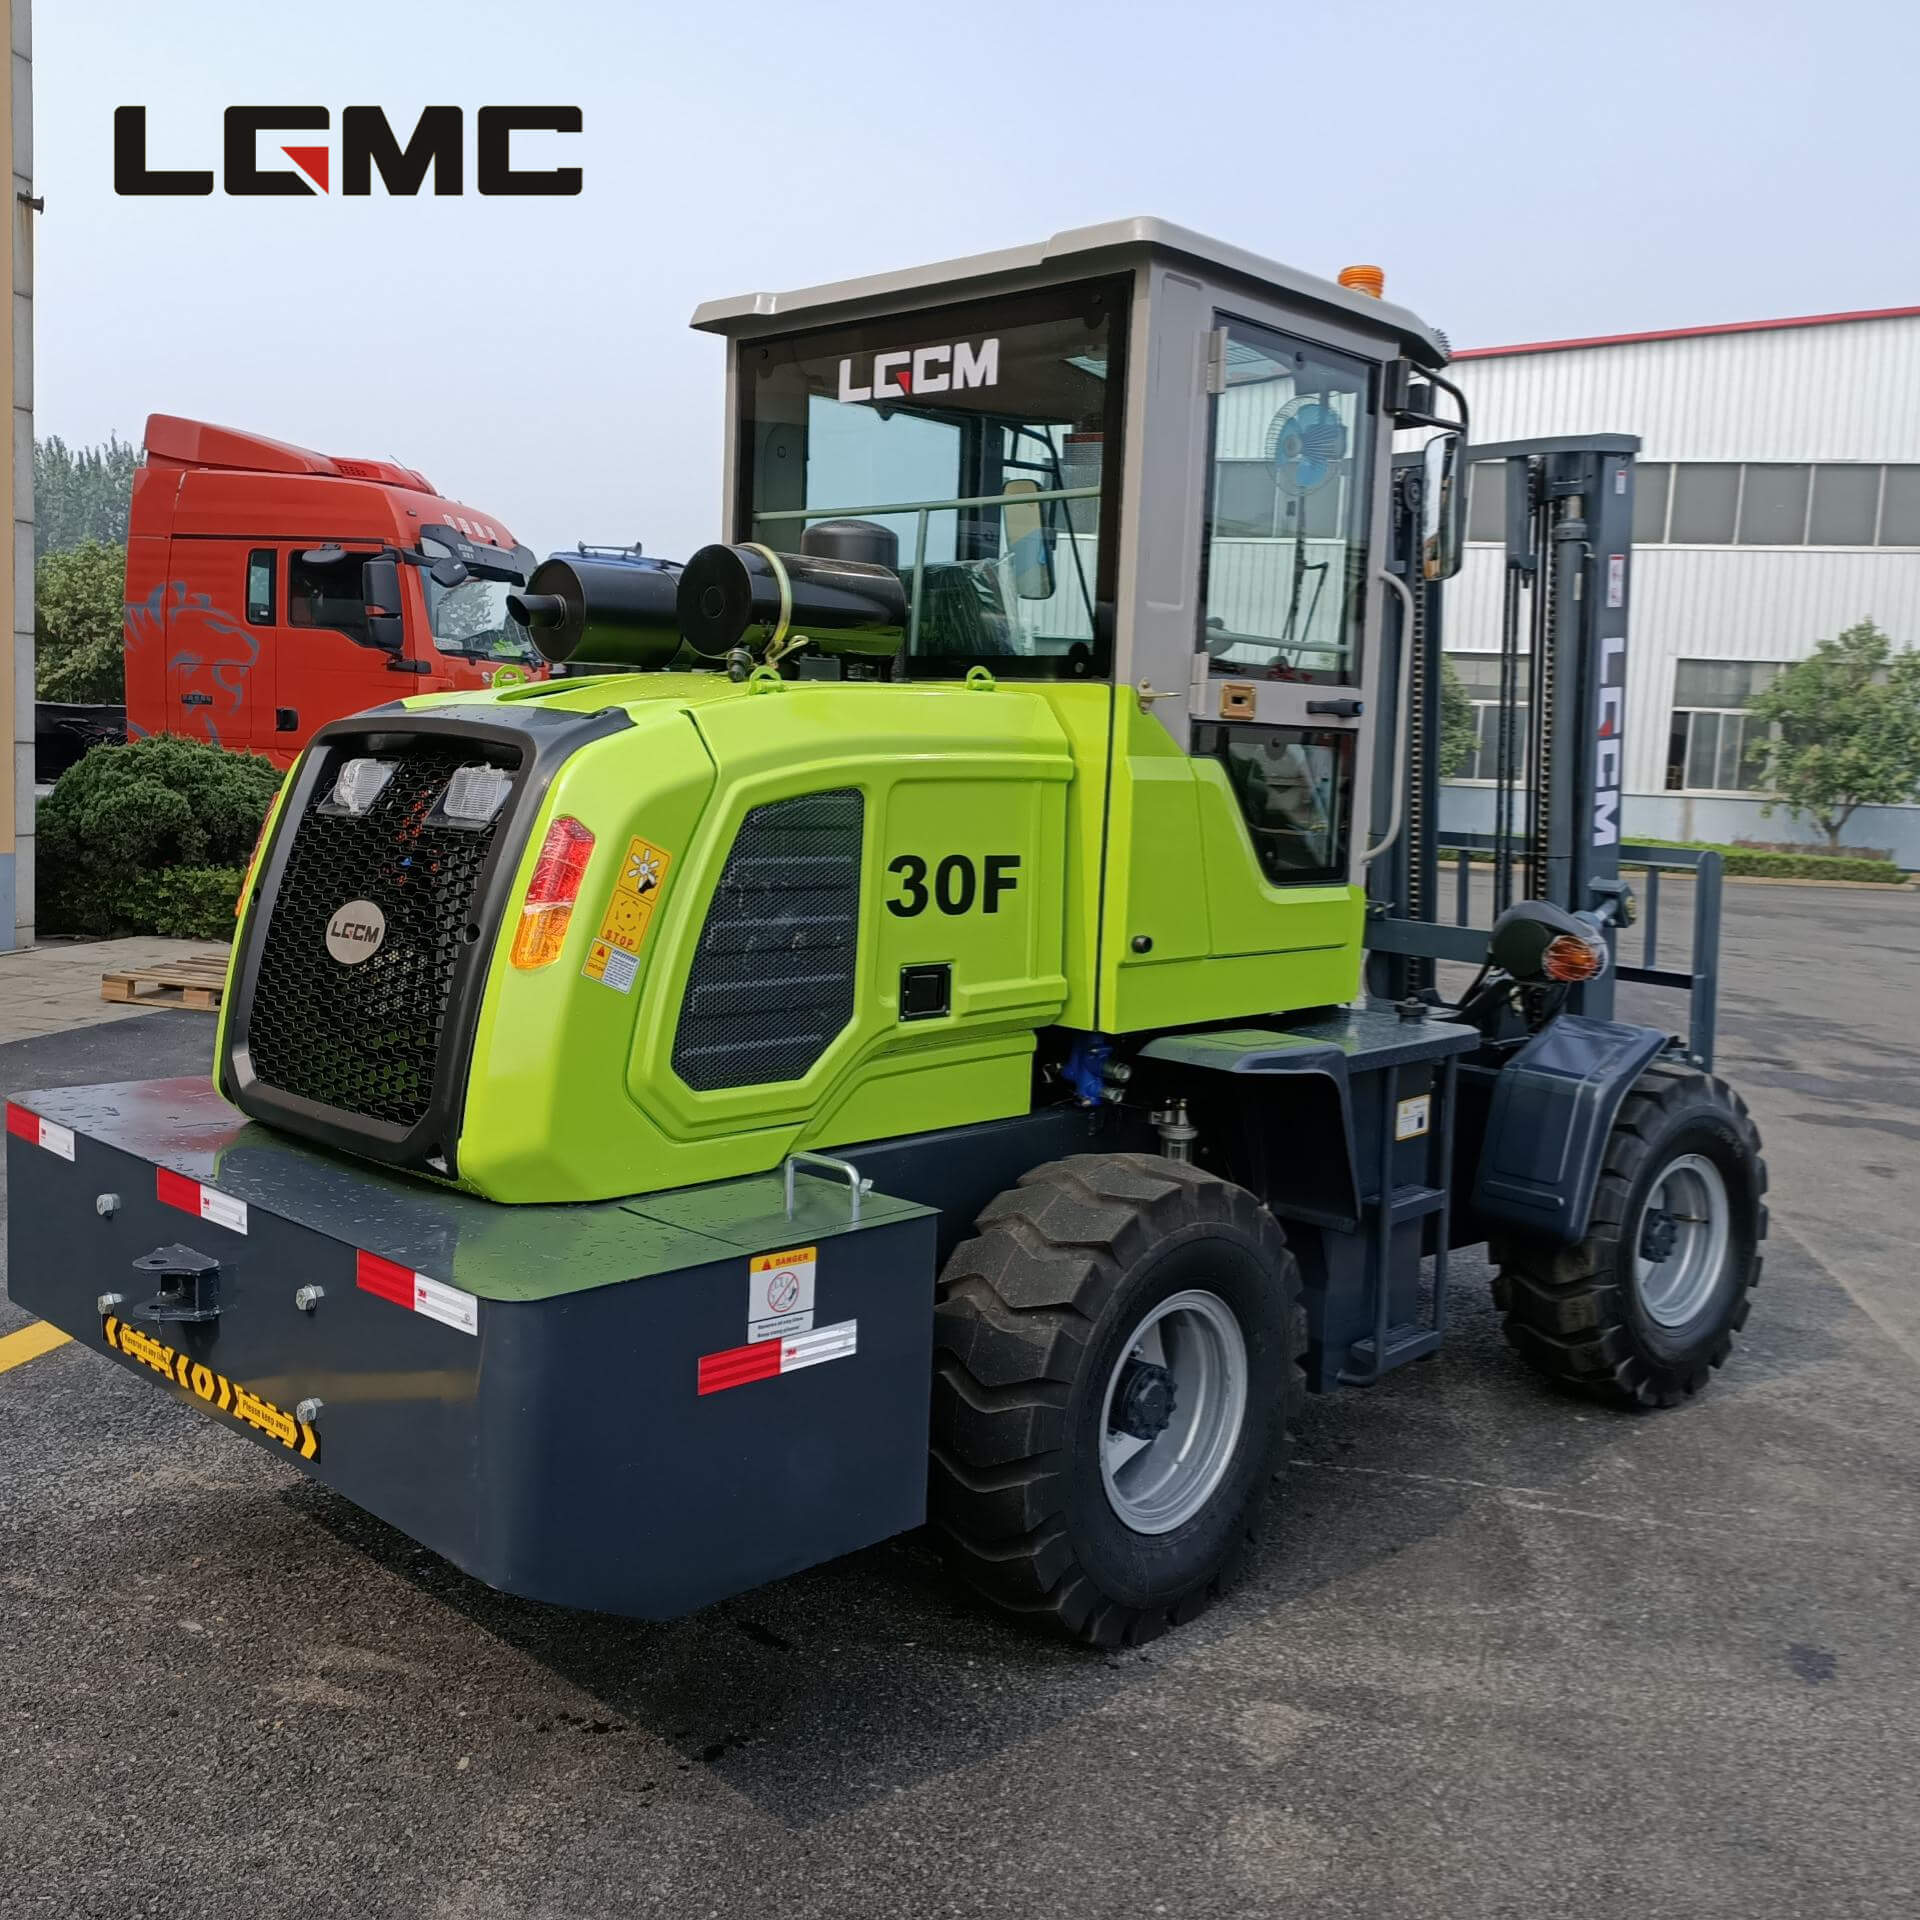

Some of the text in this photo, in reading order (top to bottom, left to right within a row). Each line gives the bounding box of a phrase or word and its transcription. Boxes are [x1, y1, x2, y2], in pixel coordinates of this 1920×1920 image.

[838, 338, 1000, 403] LGCM
[885, 854, 1021, 918] 30F
[604, 930, 634, 948] STOP
[776, 1253, 808, 1266] DANGER
[242, 1399, 261, 1418] Please
[261, 1409, 275, 1426] keep
